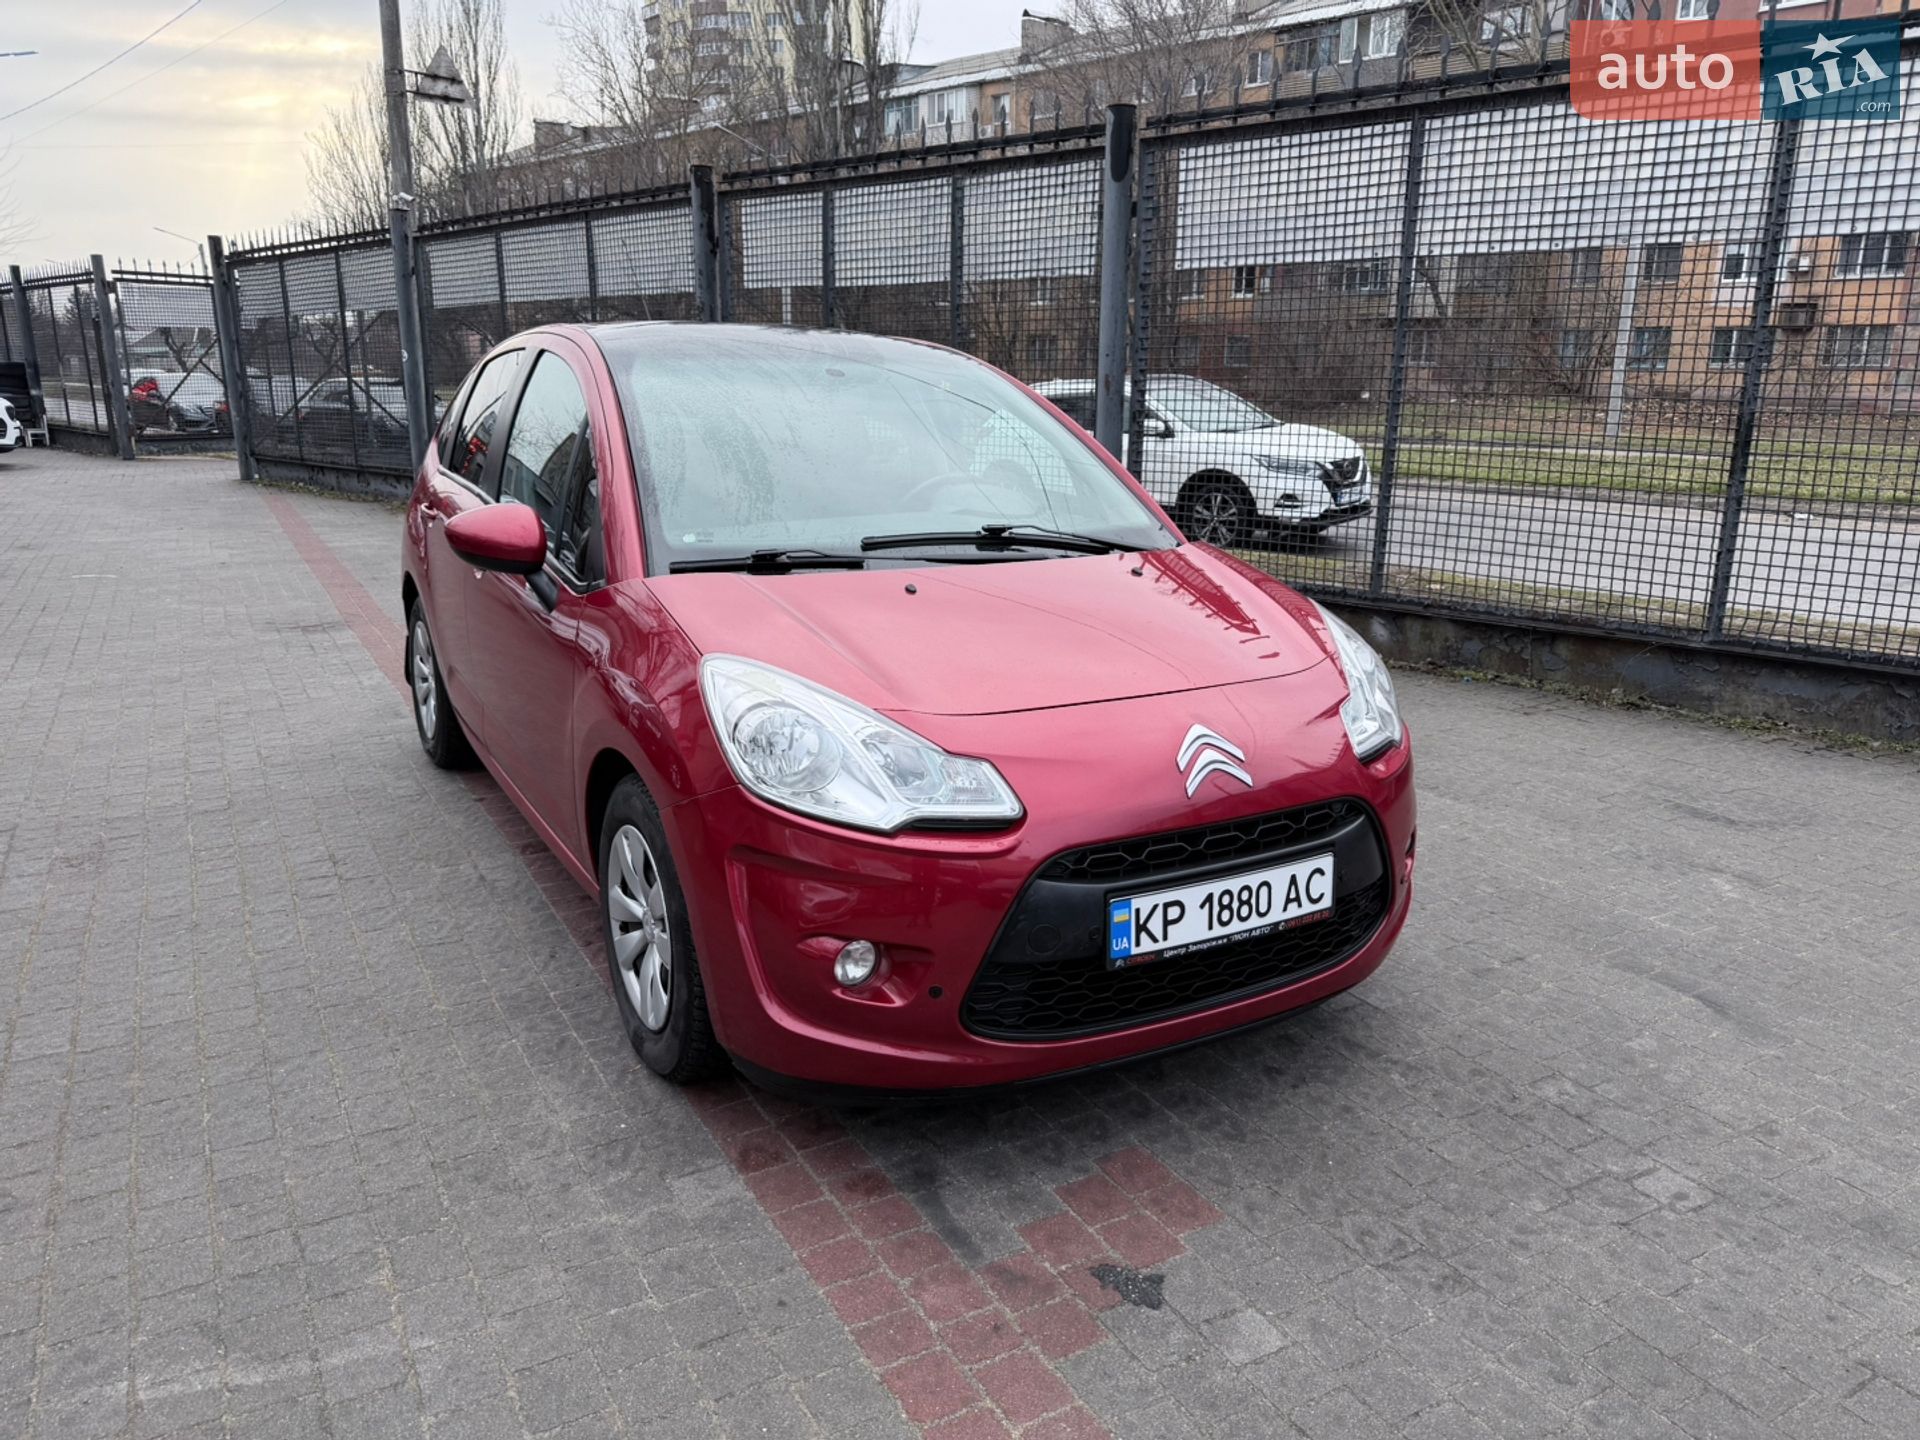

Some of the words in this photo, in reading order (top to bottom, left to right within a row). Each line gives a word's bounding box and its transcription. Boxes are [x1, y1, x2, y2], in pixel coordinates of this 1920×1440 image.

[1134, 899, 1186, 948] KP
[1199, 880, 1272, 931] 1880
[1282, 867, 1326, 913] AC
[1112, 936, 1129, 951] UA
